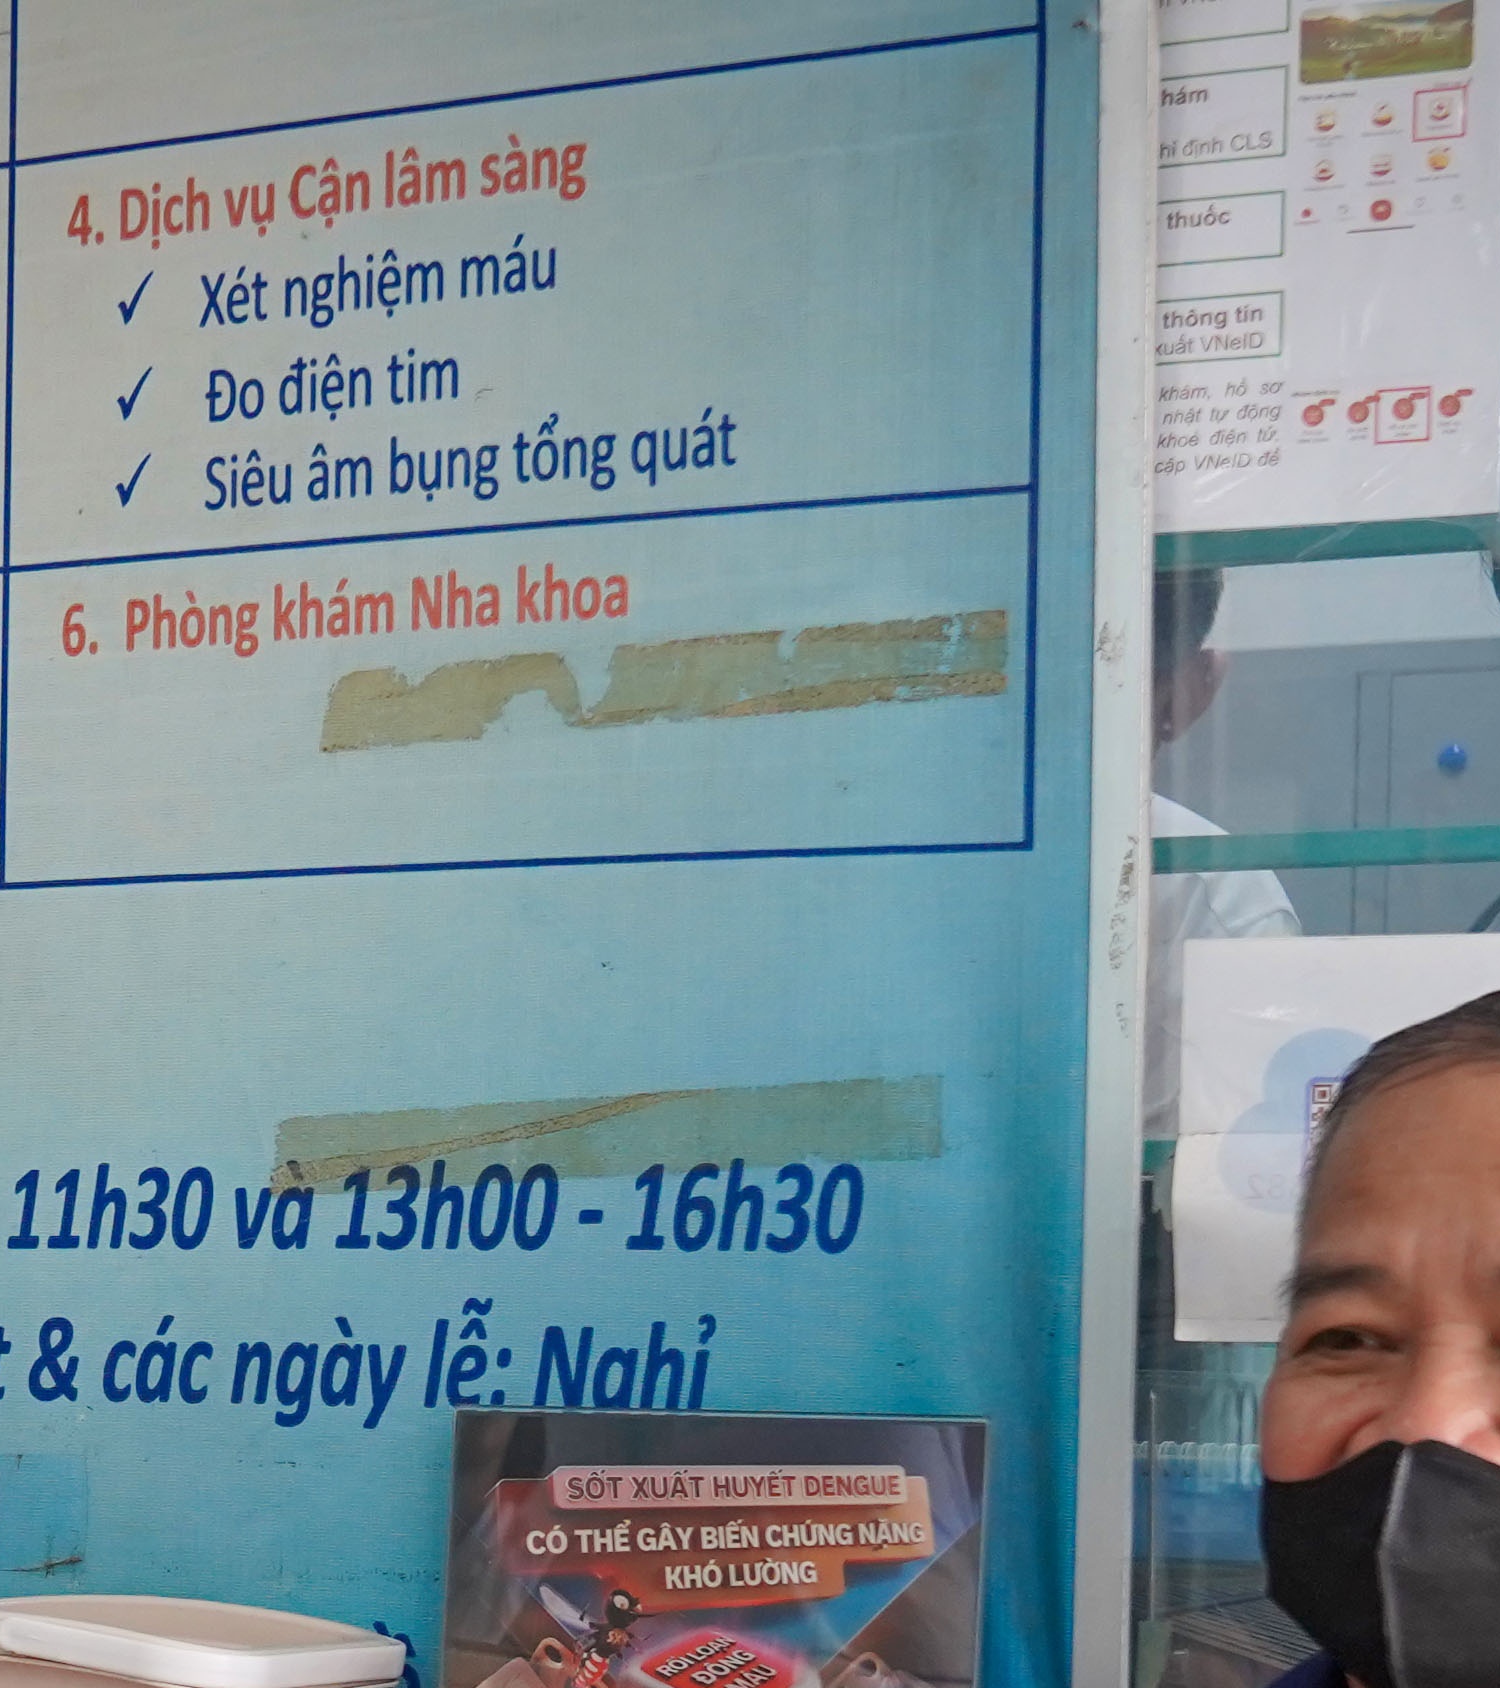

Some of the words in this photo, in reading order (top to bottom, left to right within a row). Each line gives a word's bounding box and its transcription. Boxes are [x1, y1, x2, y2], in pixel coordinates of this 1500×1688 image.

[67, 194, 105, 246] 4.
[117, 177, 210, 248] Dịch
[223, 176, 277, 234] vụ
[287, 154, 371, 225] Cận
[384, 148, 466, 206] lâm
[479, 133, 588, 201] sàng
[1167, 205, 1231, 231] thuốc
[199, 262, 268, 329] Xét
[282, 252, 446, 328] nghiệm
[459, 233, 559, 300] máu
[1162, 308, 1227, 329] thông
[205, 369, 265, 424] Đo
[279, 355, 374, 420] điện
[385, 349, 461, 407] tim
[203, 442, 294, 513] Siêu
[305, 441, 374, 503] âm
[389, 430, 499, 503] bụng
[512, 411, 616, 491] tổng
[630, 408, 738, 484] quát
[61, 603, 99, 659] 6.
[124, 586, 260, 659] Phòng
[273, 574, 396, 641] khám
[410, 571, 500, 630] Nha
[516, 565, 629, 623] khoa
[7, 1166, 214, 1252] 11h30
[234, 1159, 312, 1252] và
[335, 1163, 560, 1252] 13h00
[626, 1161, 864, 1254] 16h30
[27, 1316, 79, 1404] &
[100, 1313, 214, 1404] các
[232, 1315, 407, 1430] ngày
[423, 1296, 512, 1408] lễ:
[533, 1313, 716, 1410] Nghỉ
[567, 1468, 623, 1502] SỐT
[632, 1467, 702, 1502] XUẤT
[712, 1468, 794, 1500] HUYẾT
[803, 1473, 900, 1498] DENGUE
[526, 1519, 568, 1555] CÓ
[575, 1515, 630, 1553] THỂ
[637, 1522, 695, 1552] GÂY
[701, 1514, 759, 1550] BIẾN
[764, 1516, 851, 1548] CHỨNG
[858, 1518, 923, 1553] NẶNG
[665, 1555, 722, 1589] KHÓ
[731, 1556, 817, 1588] LƯỜNG
[656, 1653, 695, 1677] RỐI
[691, 1636, 737, 1662] LOẠN
[692, 1649, 756, 1685] ĐÔNG
